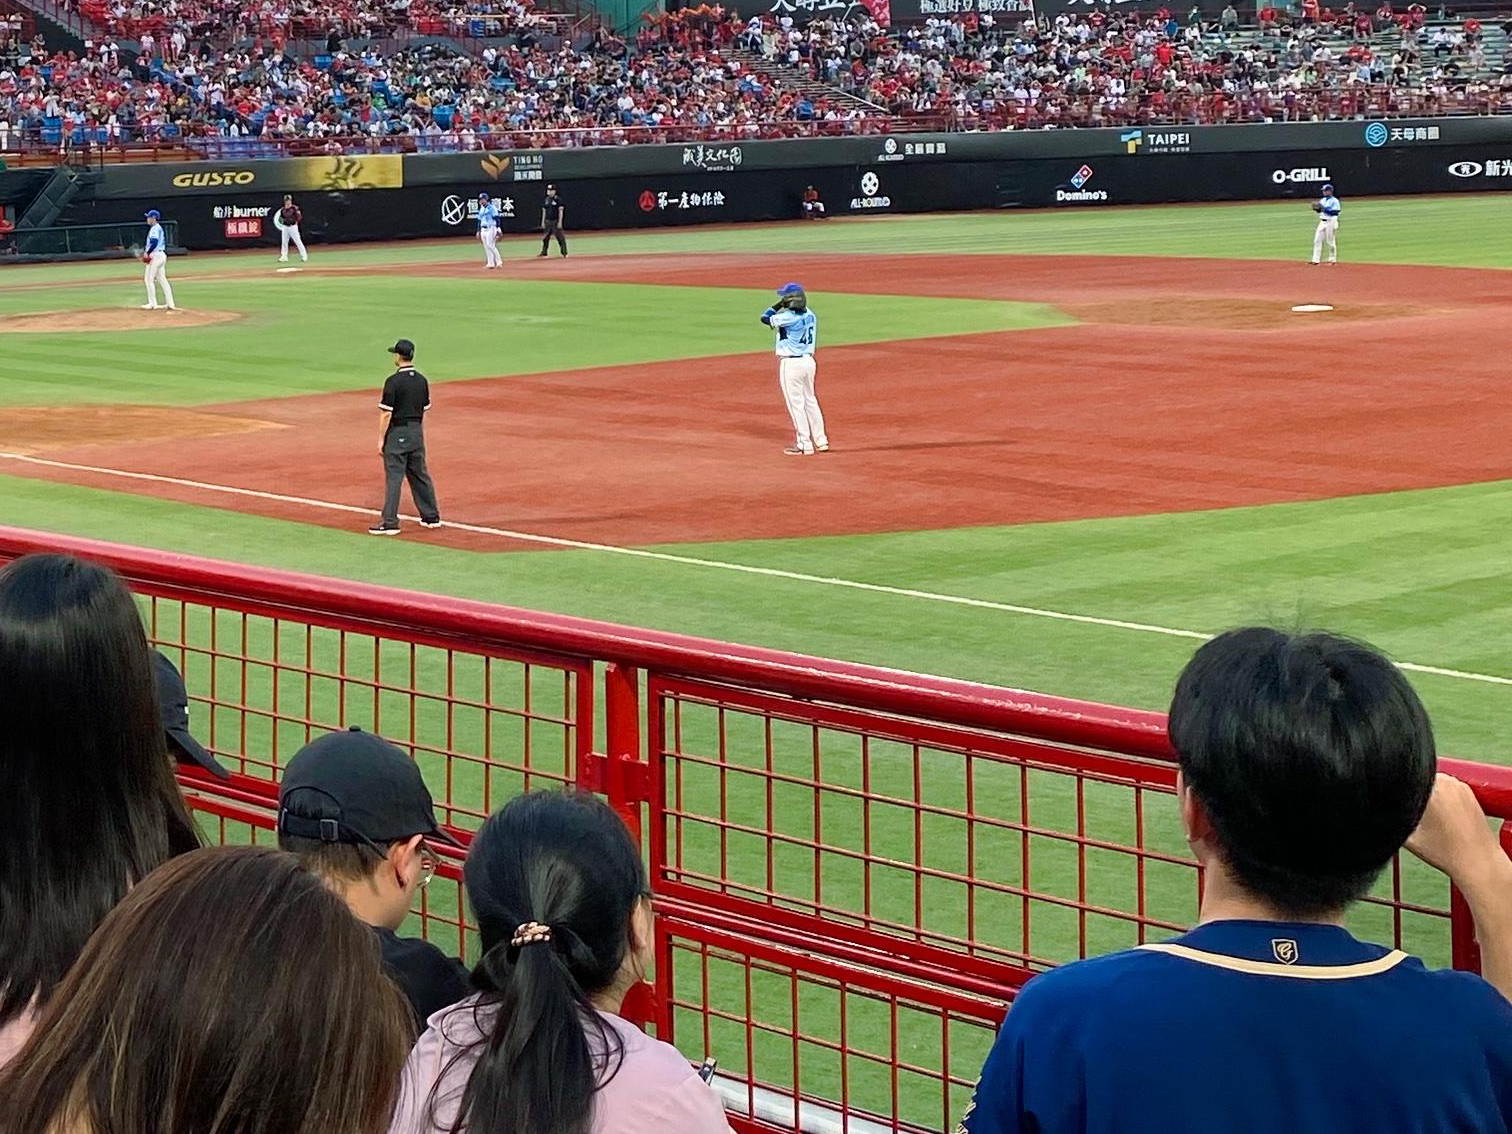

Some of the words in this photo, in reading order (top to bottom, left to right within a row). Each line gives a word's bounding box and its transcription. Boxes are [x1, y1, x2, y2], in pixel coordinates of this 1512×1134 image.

[1148, 133, 1190, 145] TAIPEI
[173, 171, 255, 187] GUSTO
[1272, 167, 1331, 183] O-GRILL
[1056, 189, 1108, 201] Domino's
